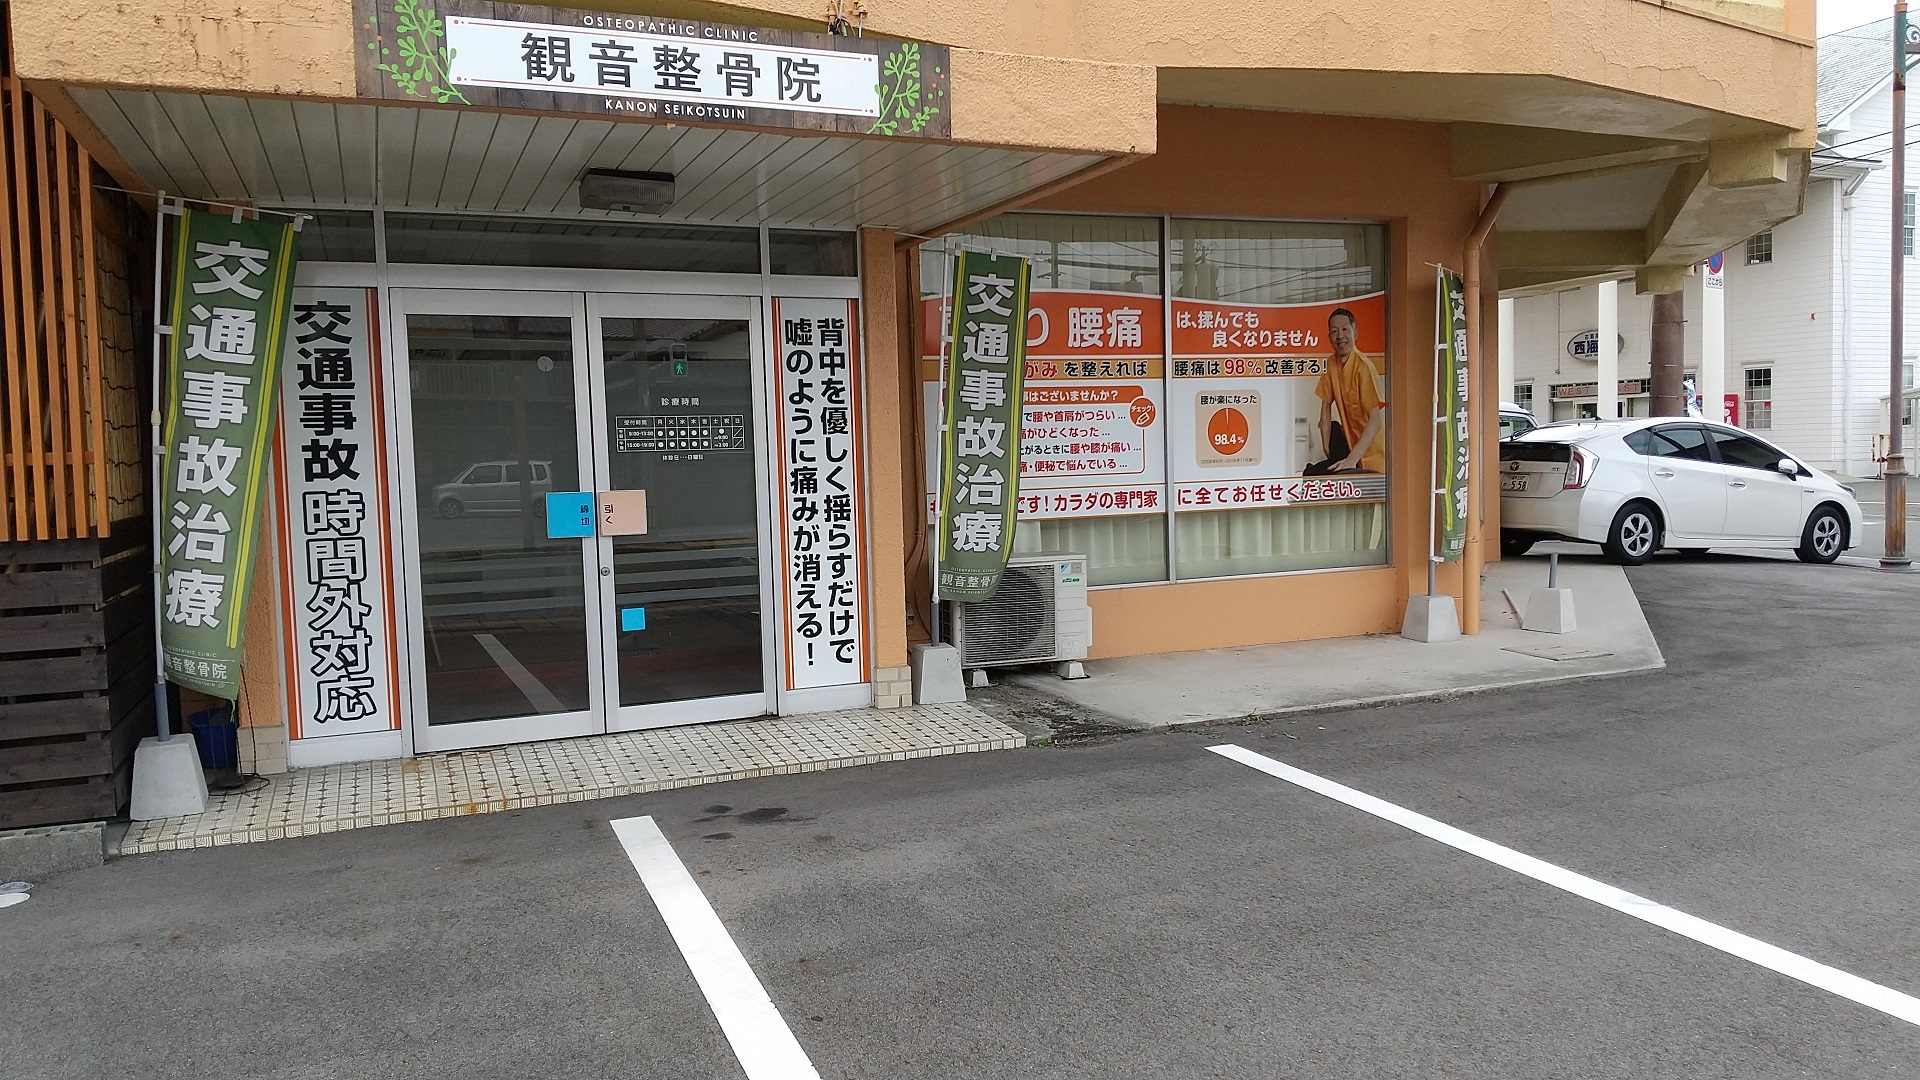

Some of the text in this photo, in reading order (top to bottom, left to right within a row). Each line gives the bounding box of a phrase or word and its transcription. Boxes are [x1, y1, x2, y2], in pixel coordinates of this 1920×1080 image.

[583, 15, 758, 42] OSTEOPATHIC CLINIC
[520, 32, 823, 102] 観音整骨院
[604, 98, 746, 120] KANON SEIKOTSUIN
[1176, 310, 1260, 329] は、揉んでも
[1212, 330, 1319, 348] 良くなりません
[661, 397, 700, 406] 診療時間
[1200, 395, 1258, 405] 腰が楽になった
[1558, 386, 1591, 396] WEST
[952, 273, 1016, 553] 交通事故治療
[165, 241, 270, 628] 交通事故治療
[816, 317, 855, 664] 背中を優しく揺らすだけで
[604, 504, 614, 525] 引く
